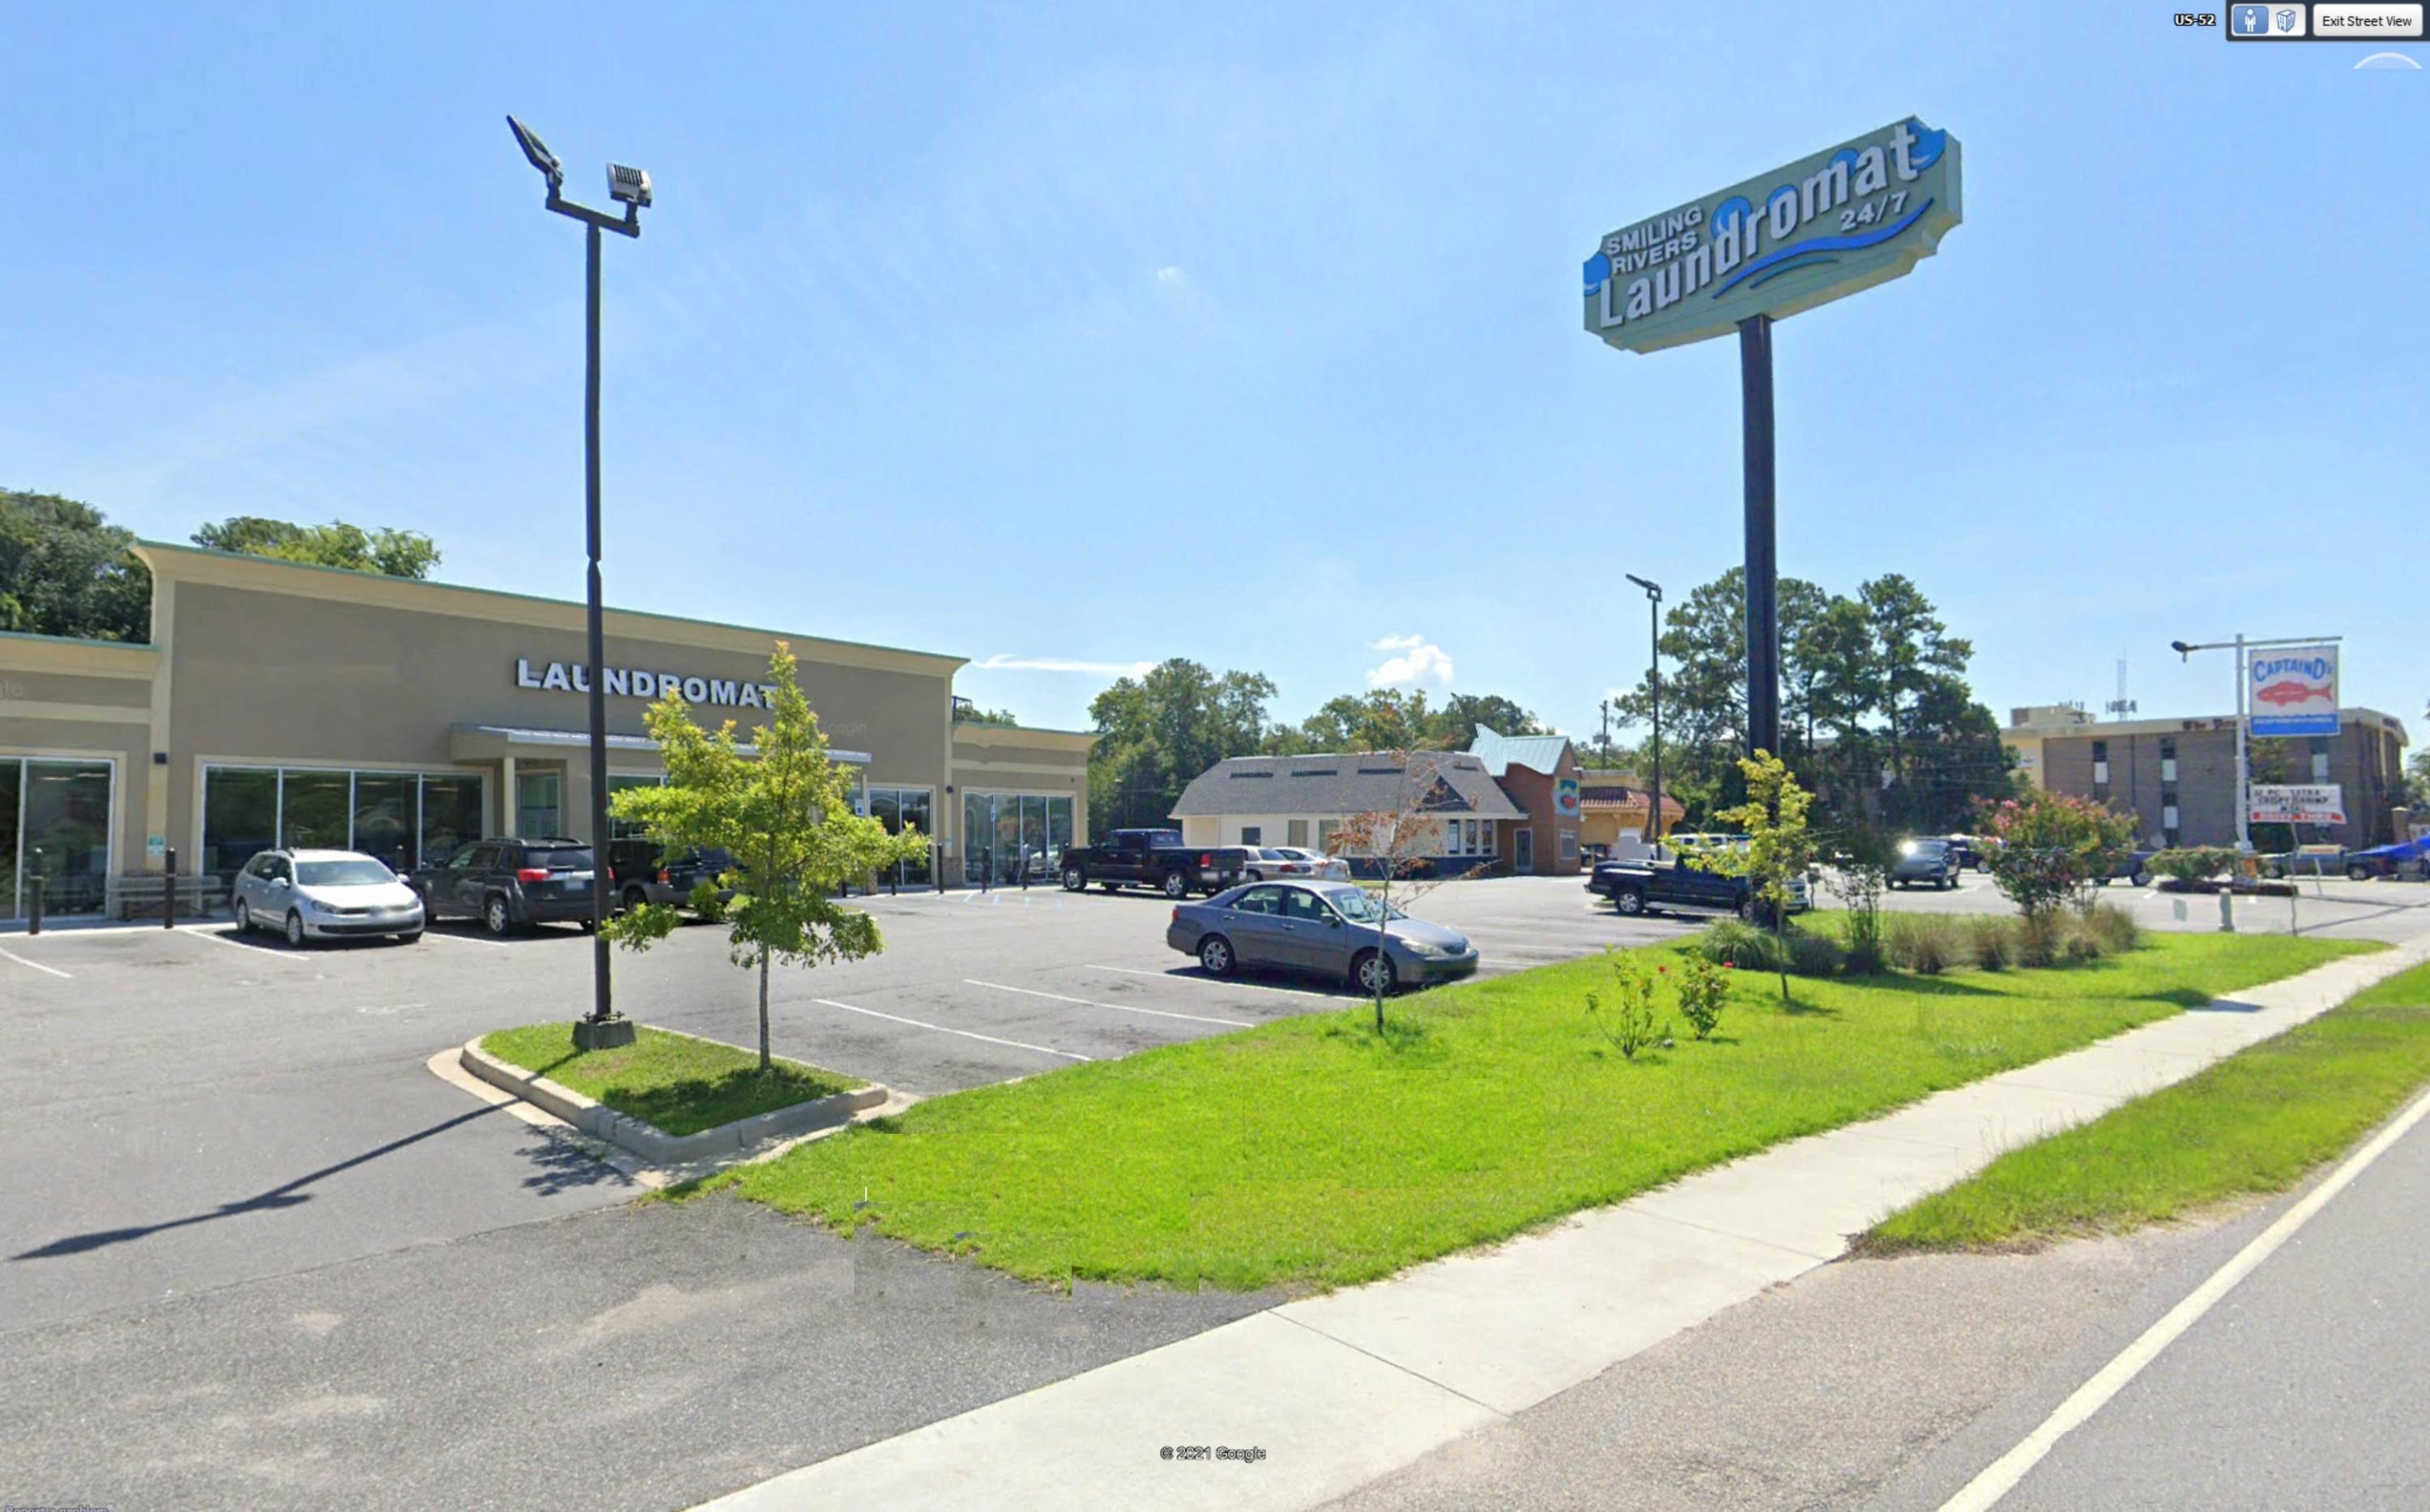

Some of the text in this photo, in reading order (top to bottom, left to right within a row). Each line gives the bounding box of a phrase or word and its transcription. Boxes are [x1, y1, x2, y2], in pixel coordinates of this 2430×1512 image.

[1599, 123, 1921, 328] Laundromat
[1606, 206, 1703, 256] SMILING
[1839, 190, 1909, 232] 24/7
[1611, 230, 1699, 275] RIVERS
[516, 658, 780, 709] LAUNDROMAT
